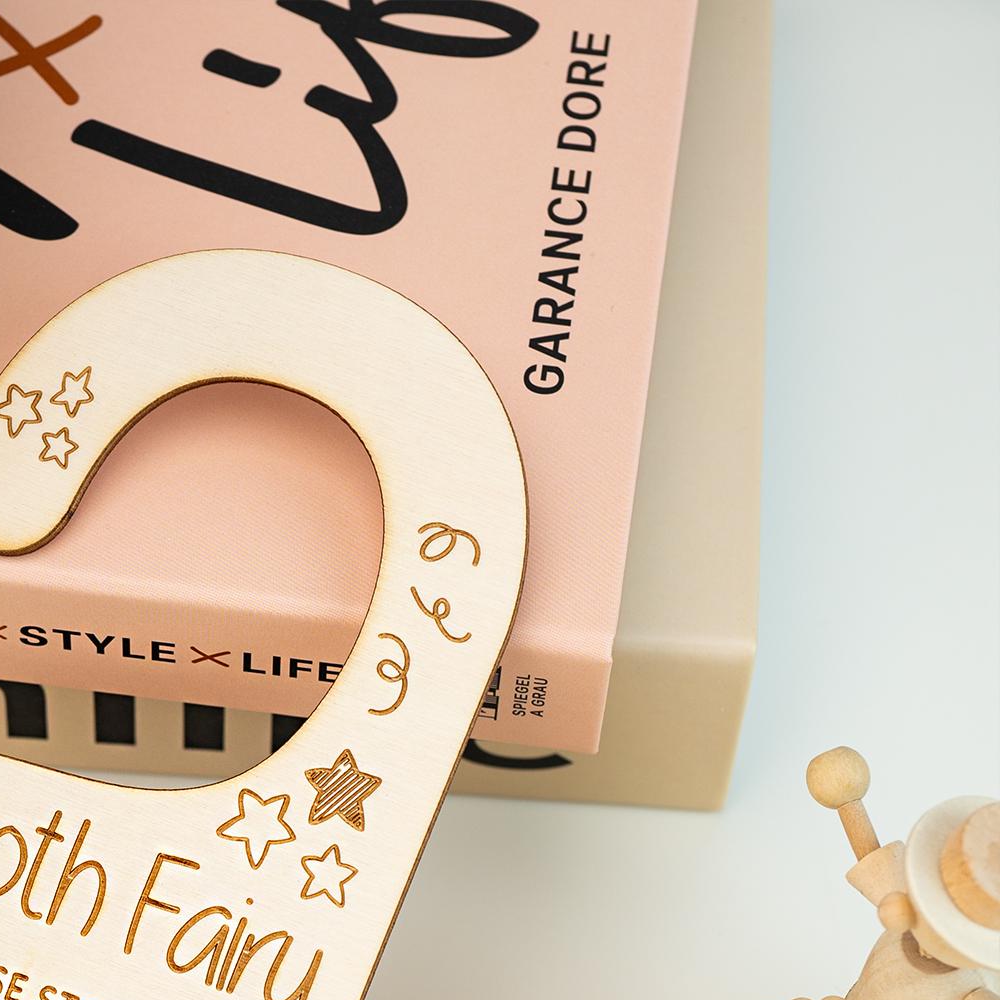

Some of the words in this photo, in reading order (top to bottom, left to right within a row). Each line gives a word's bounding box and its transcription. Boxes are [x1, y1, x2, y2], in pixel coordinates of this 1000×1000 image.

[556, 30, 612, 154] DORE
[523, 166, 592, 396] GARANCE
[19, 625, 177, 663] STYLE
[242, 652, 345, 683] LIFE
[511, 674, 531, 717] SPIEGEL
[530, 677, 549, 707] GRAU
